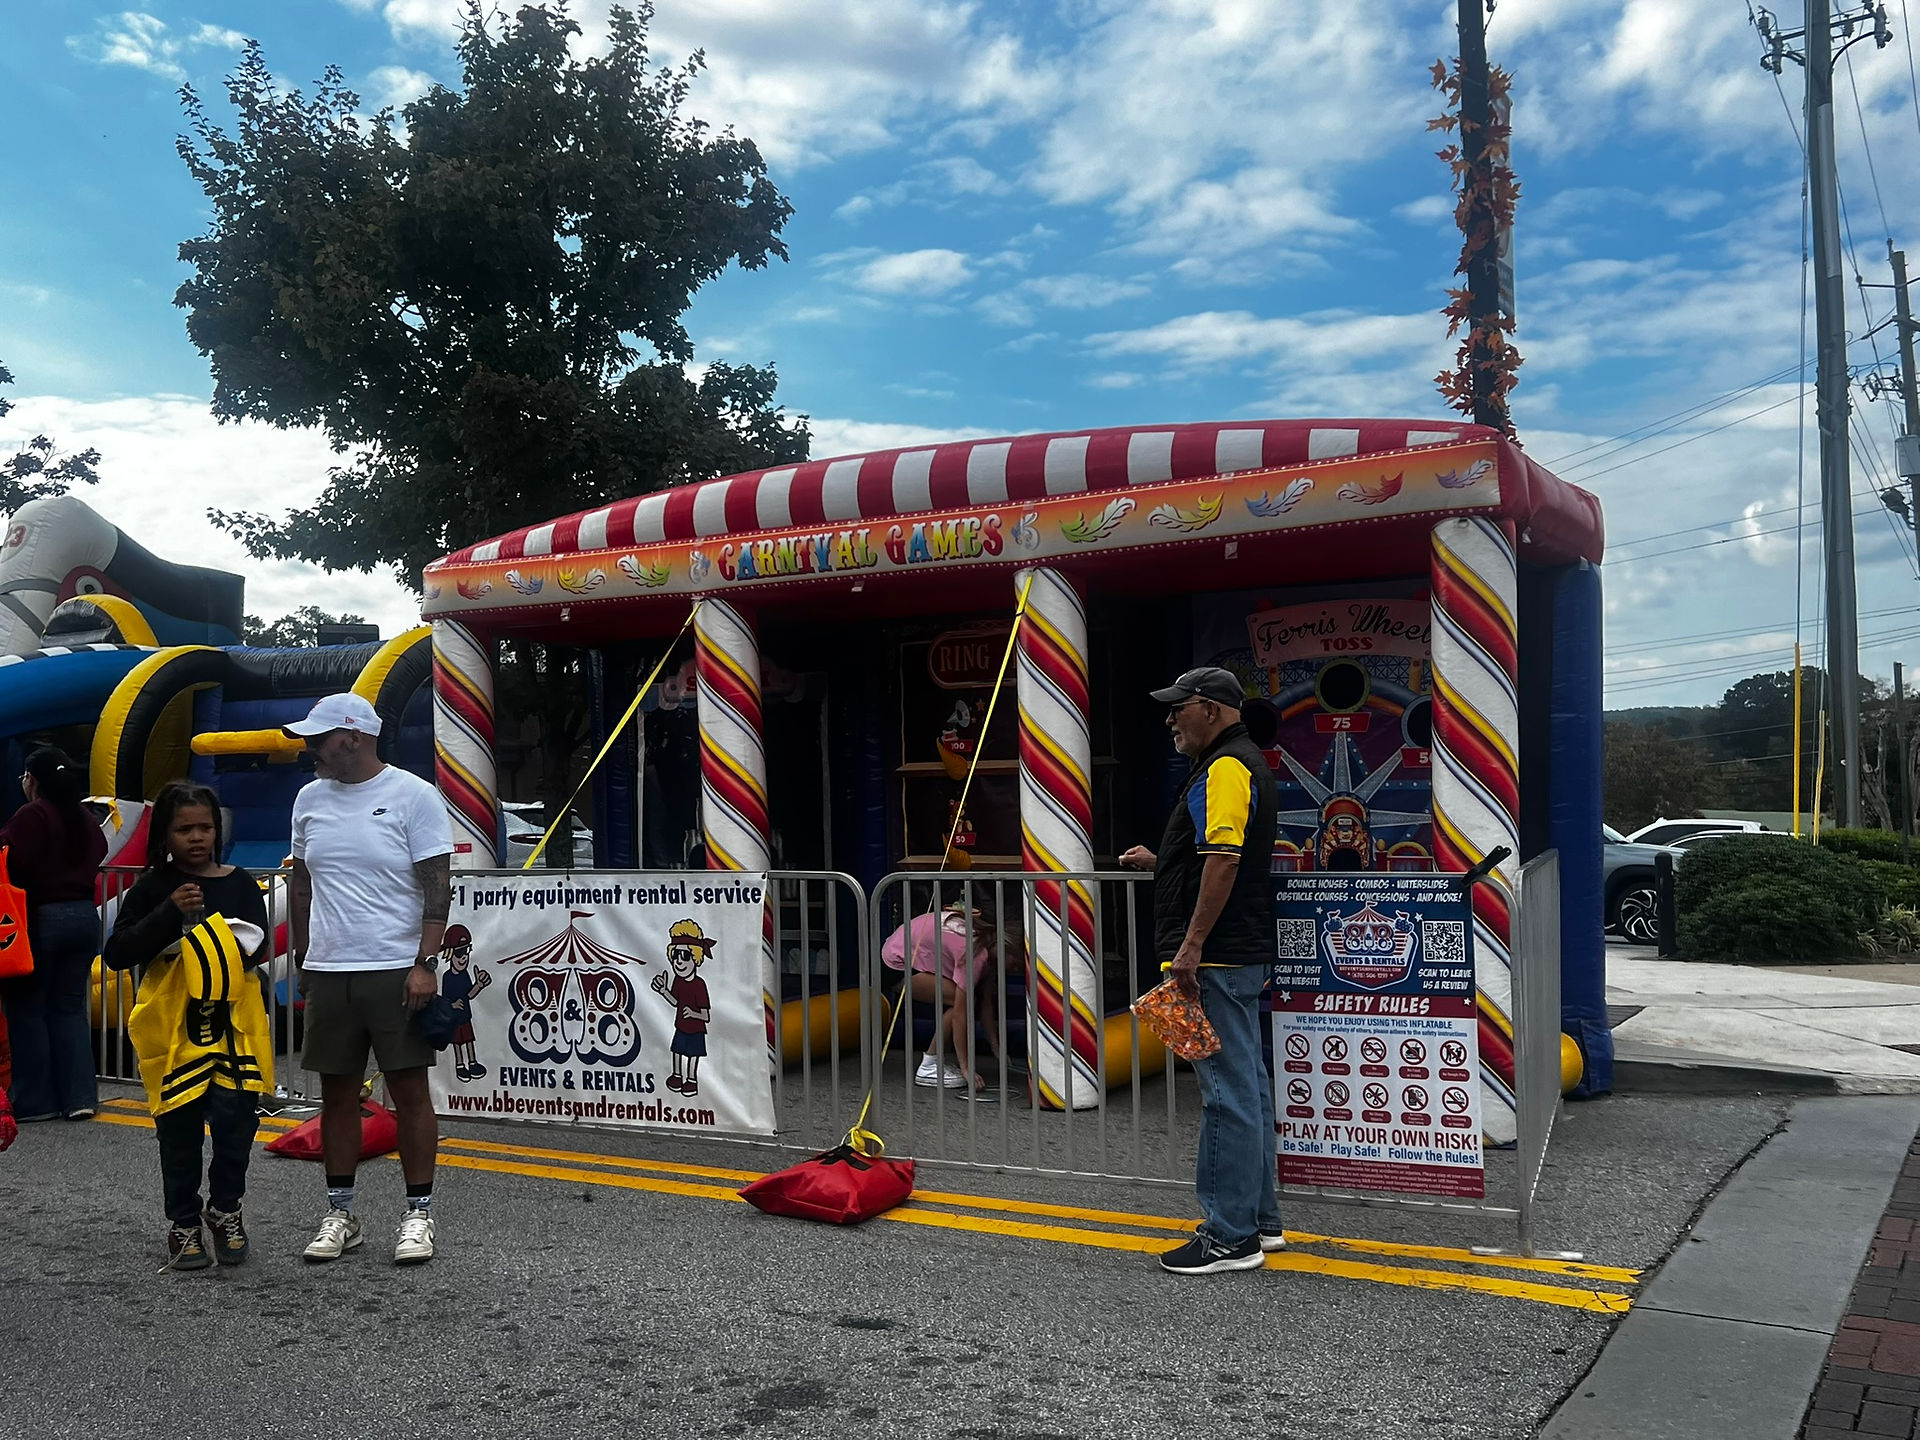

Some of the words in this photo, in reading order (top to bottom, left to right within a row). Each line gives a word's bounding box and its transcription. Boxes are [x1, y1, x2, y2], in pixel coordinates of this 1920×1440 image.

[717, 528, 878, 582] CARNIVAL
[885, 514, 1004, 565] GAMES
[1256, 610, 1339, 652] Ferris
[1320, 636, 1373, 651] TOSS
[940, 643, 991, 671] RING
[1332, 717, 1351, 729] 75
[951, 742, 965, 750] 100
[955, 835, 966, 843] 50
[1287, 879, 1317, 889] BOUNCE
[1318, 878, 1349, 889] HOUSES
[1355, 879, 1389, 889] COMBOS
[1396, 879, 1449, 889] WATERSLIDES
[473, 886, 517, 911] party
[522, 880, 621, 909] equipment
[628, 880, 687, 905] rental
[693, 879, 762, 905] service
[1276, 891, 1313, 901] OBSTACLE
[1314, 892, 1349, 902] COURSES
[1355, 892, 1410, 902] CONCESSIONS
[1416, 892, 1434, 903] AND
[1434, 892, 1463, 903] MORE!
[1335, 957, 1363, 965] EVENTS
[1371, 957, 1405, 965] RENTALS
[1274, 965, 1292, 974] SCAN
[1294, 965, 1303, 974] TO
[1304, 965, 1322, 974] VISIT
[1418, 968, 1438, 978] SCAN
[1439, 968, 1450, 978] TO
[1450, 969, 1472, 978] LEAVE
[1276, 976, 1291, 985] OUR
[1291, 976, 1321, 986] WEBSITE
[1423, 980, 1434, 989] US
[1433, 981, 1440, 989] A
[1441, 981, 1468, 990] REVIEW
[1313, 994, 1375, 1013] SAFETY
[1378, 996, 1431, 1015] RULES
[1296, 1015, 1307, 1024] WE
[1308, 1016, 1327, 1025] HOPE
[1328, 1016, 1343, 1025] YOU
[1344, 1017, 1367, 1026] ENJOY
[1367, 1018, 1389, 1027] USING
[1391, 1019, 1408, 1028] THIS
[1409, 1020, 1452, 1029] INFLATABLE
[499, 1066, 557, 1089] EVENTS
[562, 1069, 576, 1090] &
[582, 1070, 656, 1094] RENTALS
[448, 1089, 716, 1126] www.bbeventsandrentals.com
[1283, 1122, 1319, 1140] PLAY
[1323, 1125, 1341, 1142] AT
[1345, 1126, 1387, 1145] YOUR
[1392, 1129, 1430, 1148] OWN
[1435, 1132, 1478, 1151] RISK!
[1283, 1140, 1296, 1152] Be
[1298, 1141, 1323, 1154] Safe!
[1331, 1144, 1352, 1157] Play
[1355, 1145, 1381, 1158] Safe!
[1388, 1147, 1424, 1161] Follow
[1426, 1149, 1442, 1163] the
[1445, 1151, 1479, 1164] Rules!
